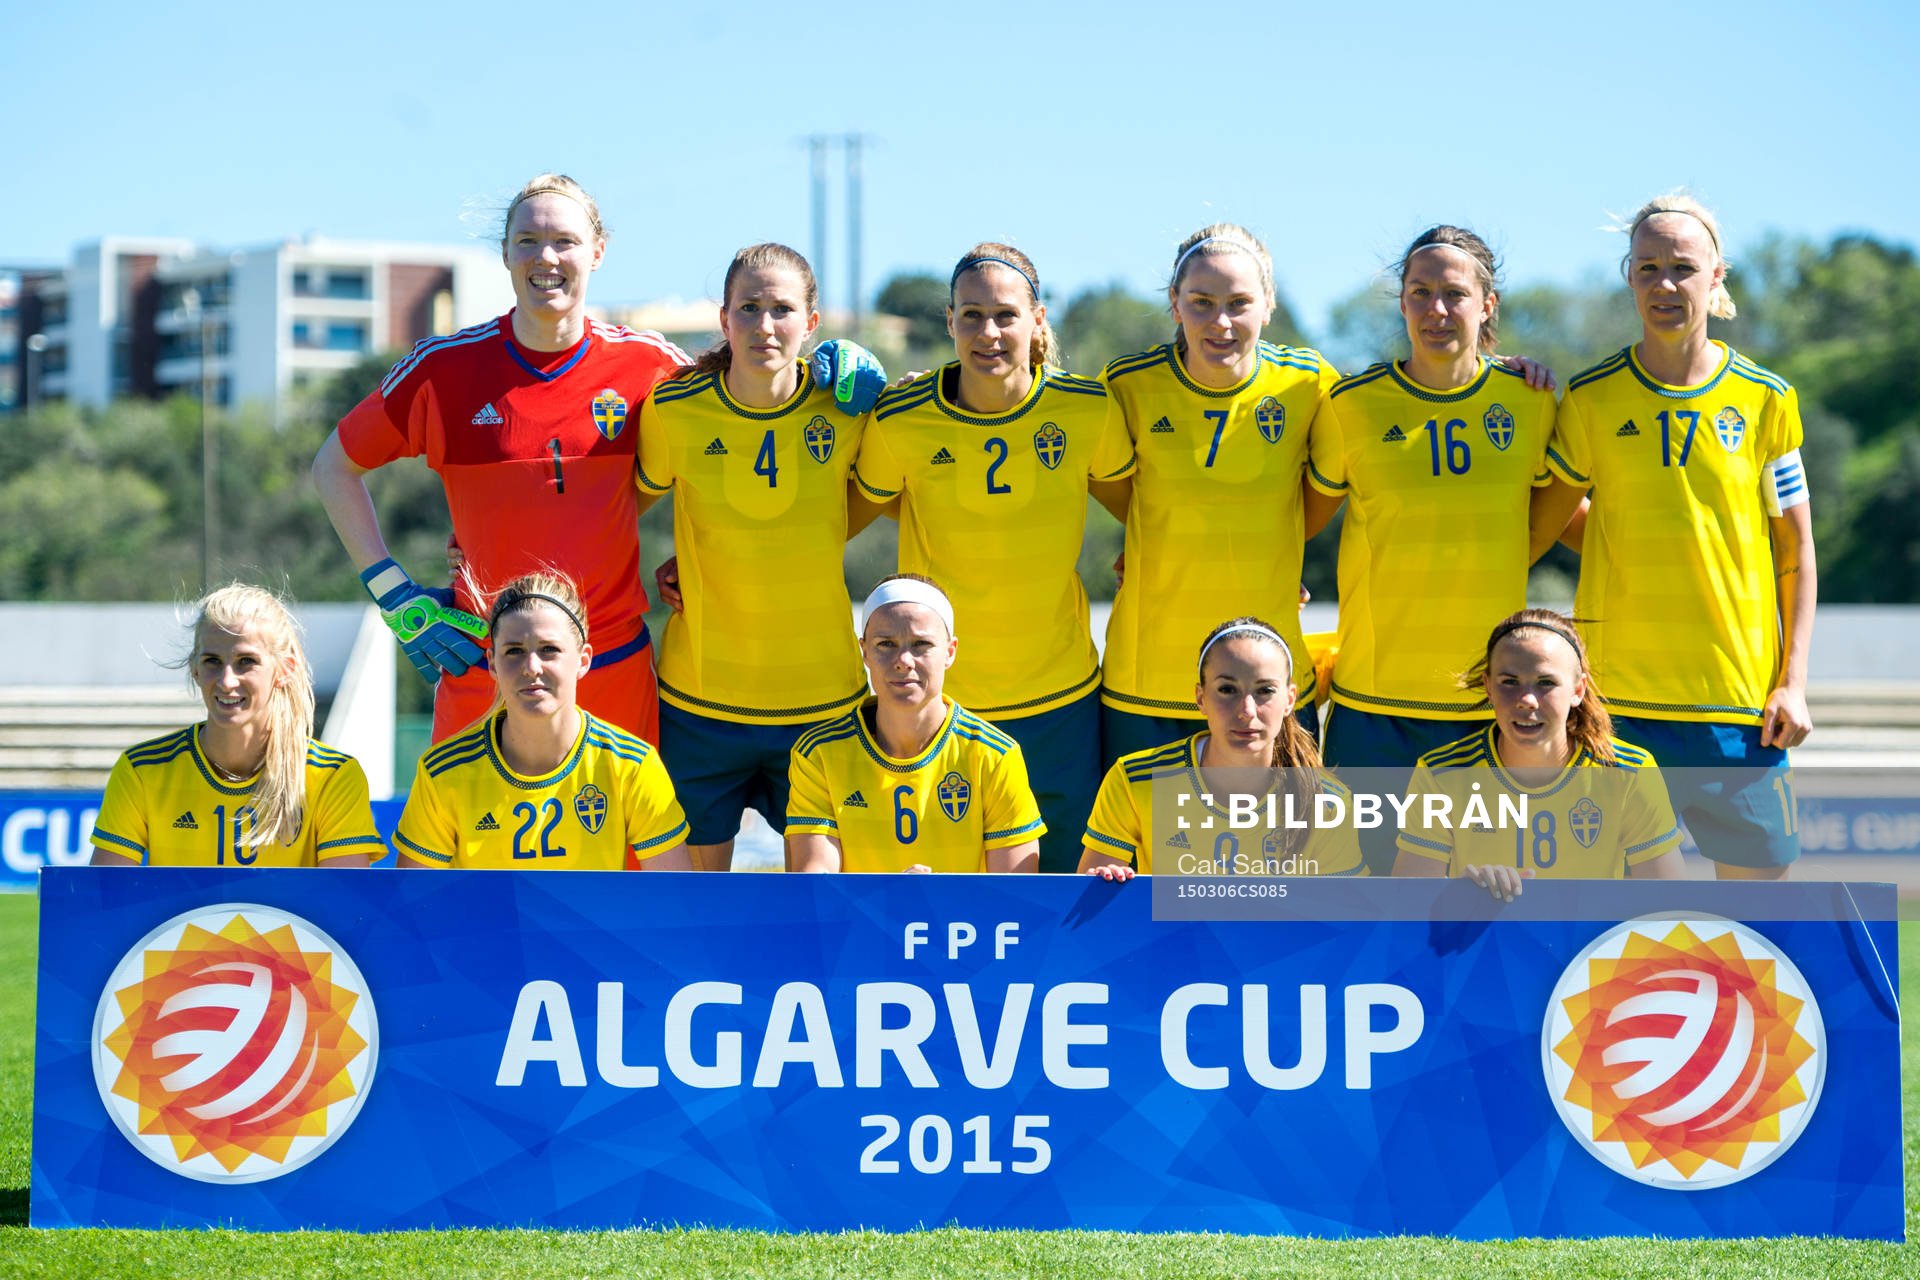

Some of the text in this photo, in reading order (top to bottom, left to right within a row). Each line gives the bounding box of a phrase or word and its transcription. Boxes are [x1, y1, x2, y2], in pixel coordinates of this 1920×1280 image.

[472, 416, 504, 425] adidas
[1204, 410, 1229, 467] 7
[1424, 418, 1471, 476] 16
[1655, 410, 1701, 467] 17
[547, 437, 565, 494] 1
[753, 430, 779, 488] 4
[984, 437, 1011, 494] 2
[475, 823, 501, 831] adidas
[512, 797, 566, 859] 22
[843, 800, 868, 808] adidas
[894, 785, 918, 844] 6
[213, 804, 258, 866] 10
[1165, 840, 1191, 849] adidas
[1513, 810, 1557, 868] 18
[495, 980, 1425, 1090] ALGARVE CUP
[859, 1114, 1052, 1174] 2015
